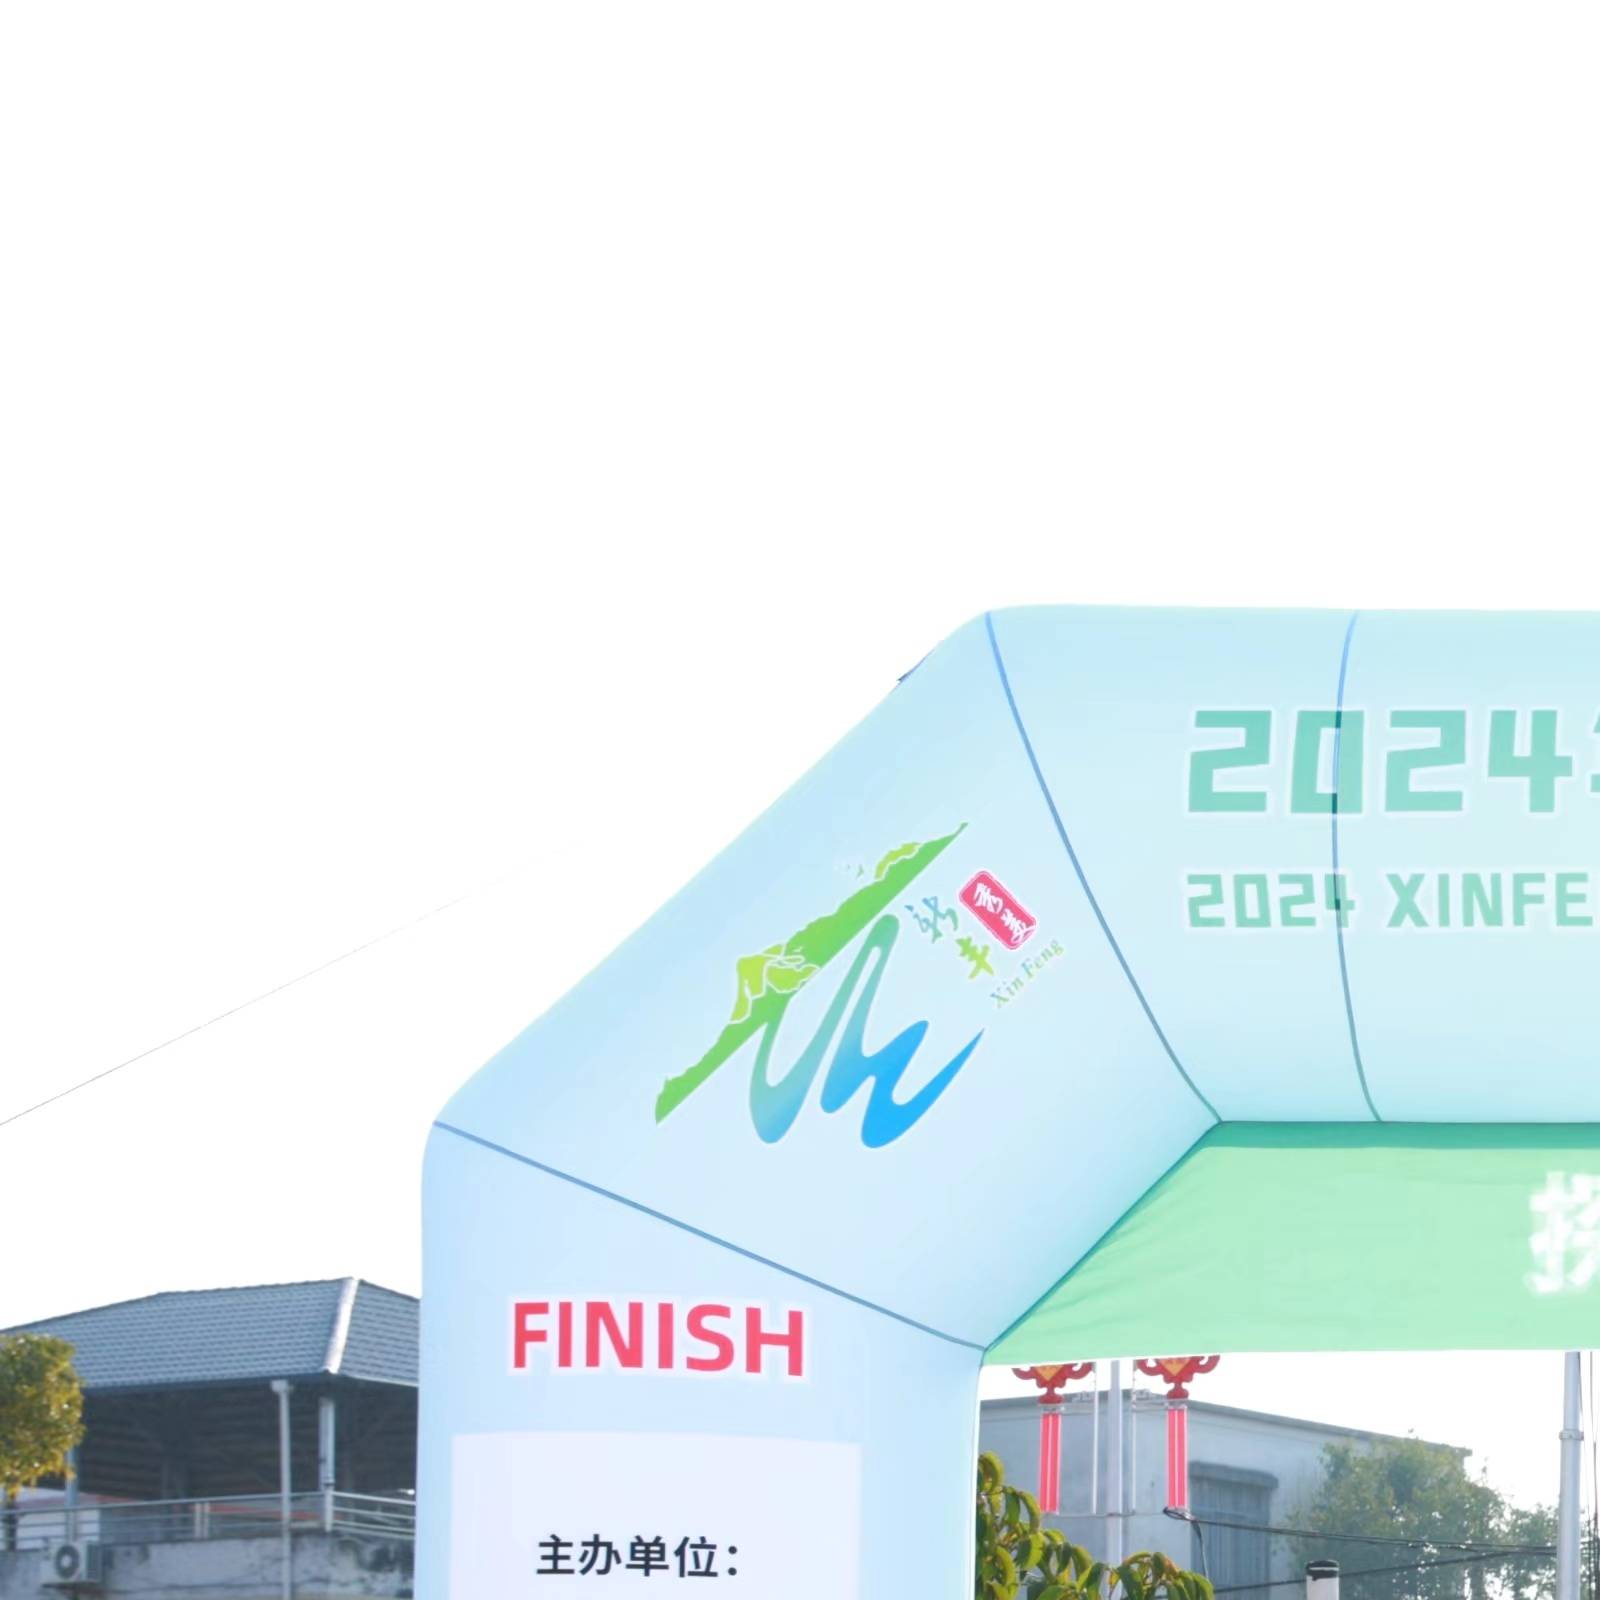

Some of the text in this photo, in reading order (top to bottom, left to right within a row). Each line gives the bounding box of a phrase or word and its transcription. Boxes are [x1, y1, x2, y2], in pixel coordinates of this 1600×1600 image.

[1185, 871, 1355, 928] 2024
[513, 1300, 804, 1377] FINISH
[536, 1534, 739, 1578] 主办单位：
